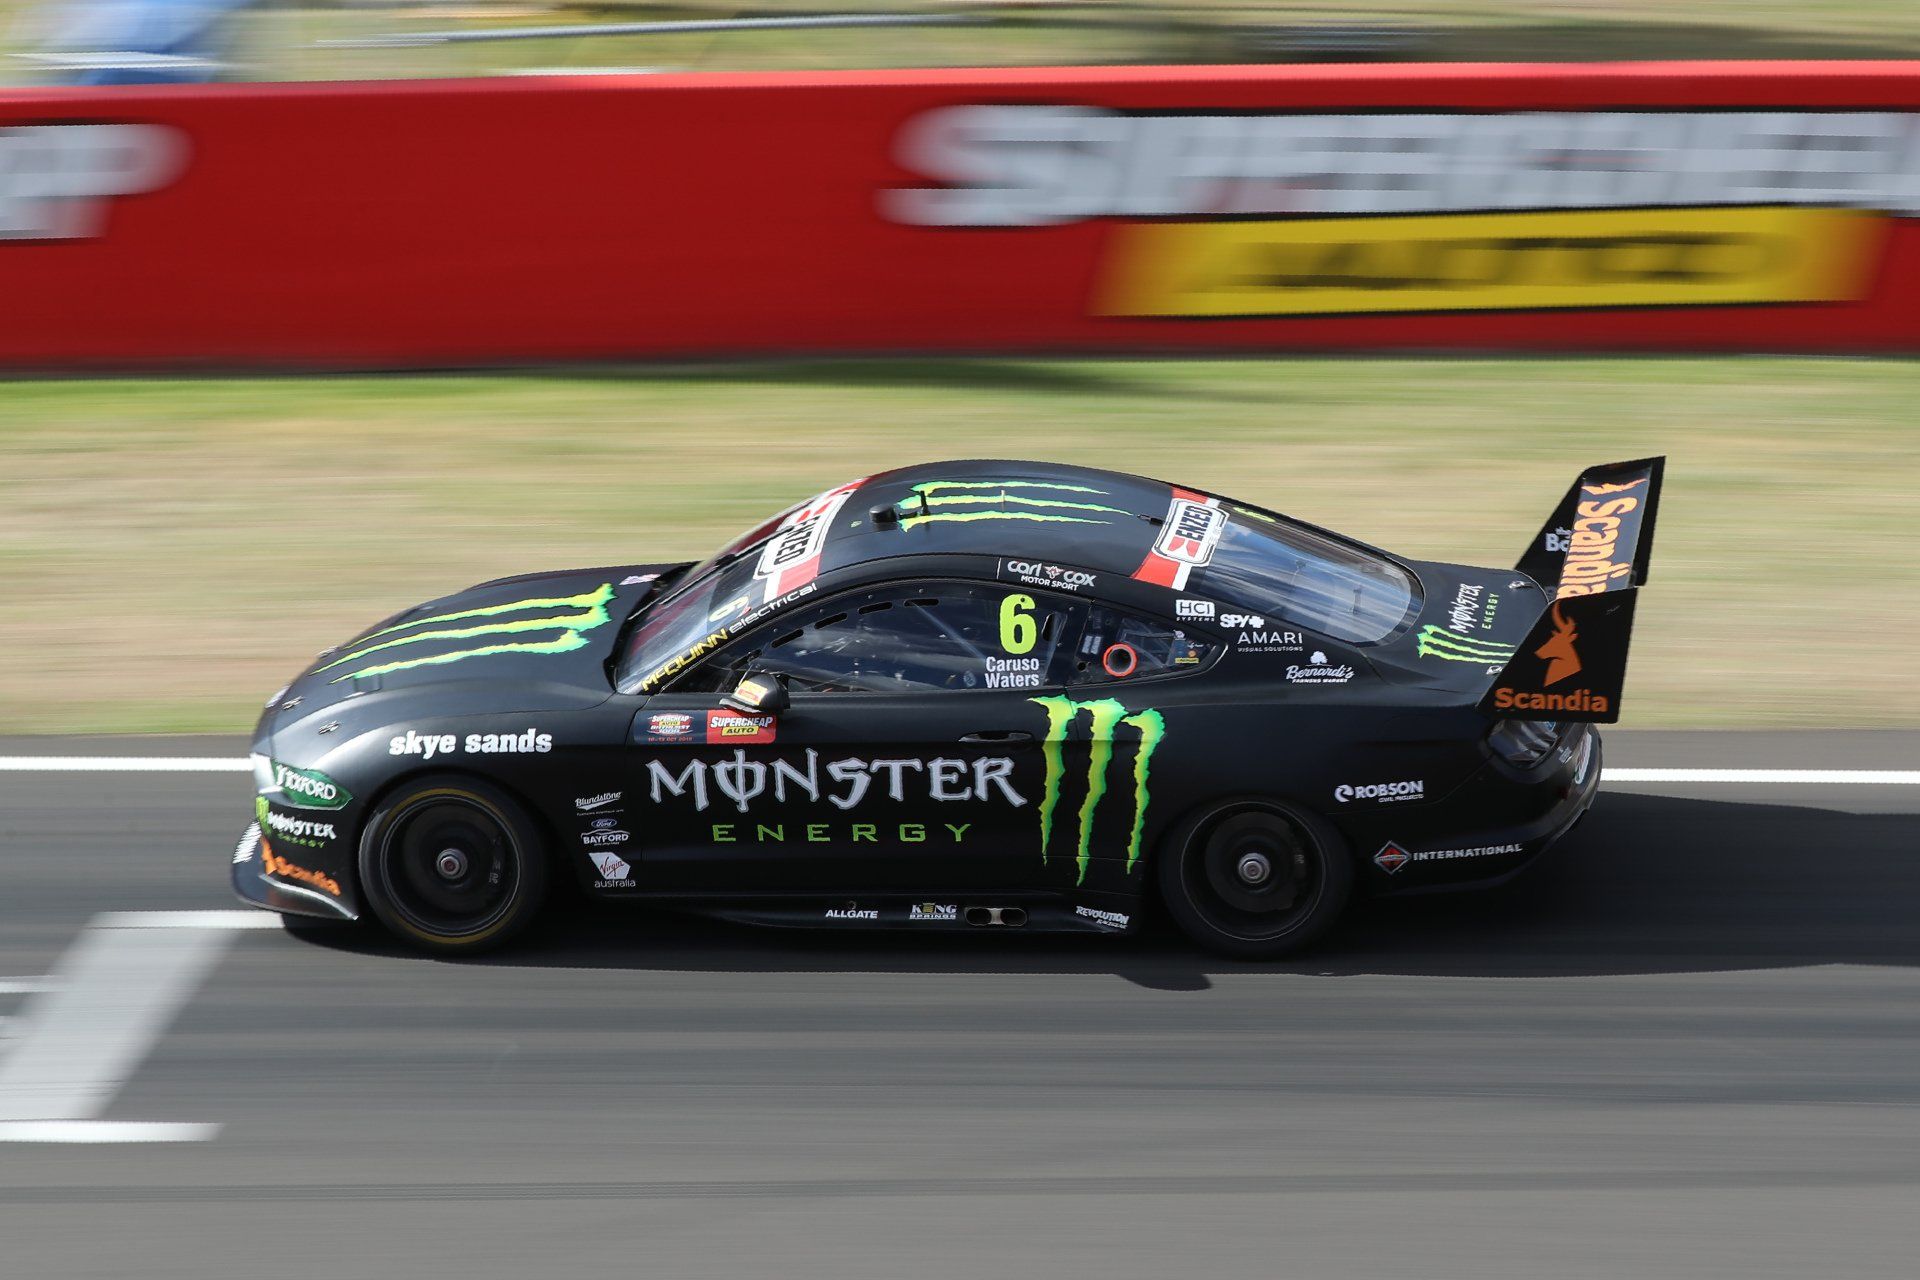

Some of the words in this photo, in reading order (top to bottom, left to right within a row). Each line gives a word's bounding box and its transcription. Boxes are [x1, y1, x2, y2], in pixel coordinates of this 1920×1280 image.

[1175, 505, 1213, 541] ENZED
[1007, 560, 1042, 577] carl
[1063, 570, 1097, 587] cox
[1020, 575, 1051, 587] MOTOR
[1051, 580, 1080, 591] SPORT
[1179, 602, 1211, 615] HCI
[1448, 583, 1484, 634] MONSTER
[1482, 593, 1499, 630] ENERGY
[1000, 593, 1037, 655] 6
[1237, 631, 1303, 645] AMARI
[985, 656, 1040, 672] Caruso
[1286, 665, 1355, 680] Bernardi's
[985, 672, 1040, 688] Waters
[1494, 687, 1609, 712] Scandia
[710, 716, 774, 728] SUPERCHEAP
[389, 730, 457, 760] skye
[465, 728, 552, 753] sands
[646, 748, 1028, 813] MONSTER
[1355, 780, 1424, 799] ROBSON
[575, 792, 623, 807] Blundstone
[583, 834, 629, 844] BAYFORD
[712, 824, 971, 842] ENERGY
[1413, 844, 1523, 861] INTERNATIONAL
[600, 856, 625, 877] Virgin
[594, 879, 636, 888] australia
[825, 909, 878, 919] ALLGATE
[1076, 905, 1129, 924] REVOLUTION
